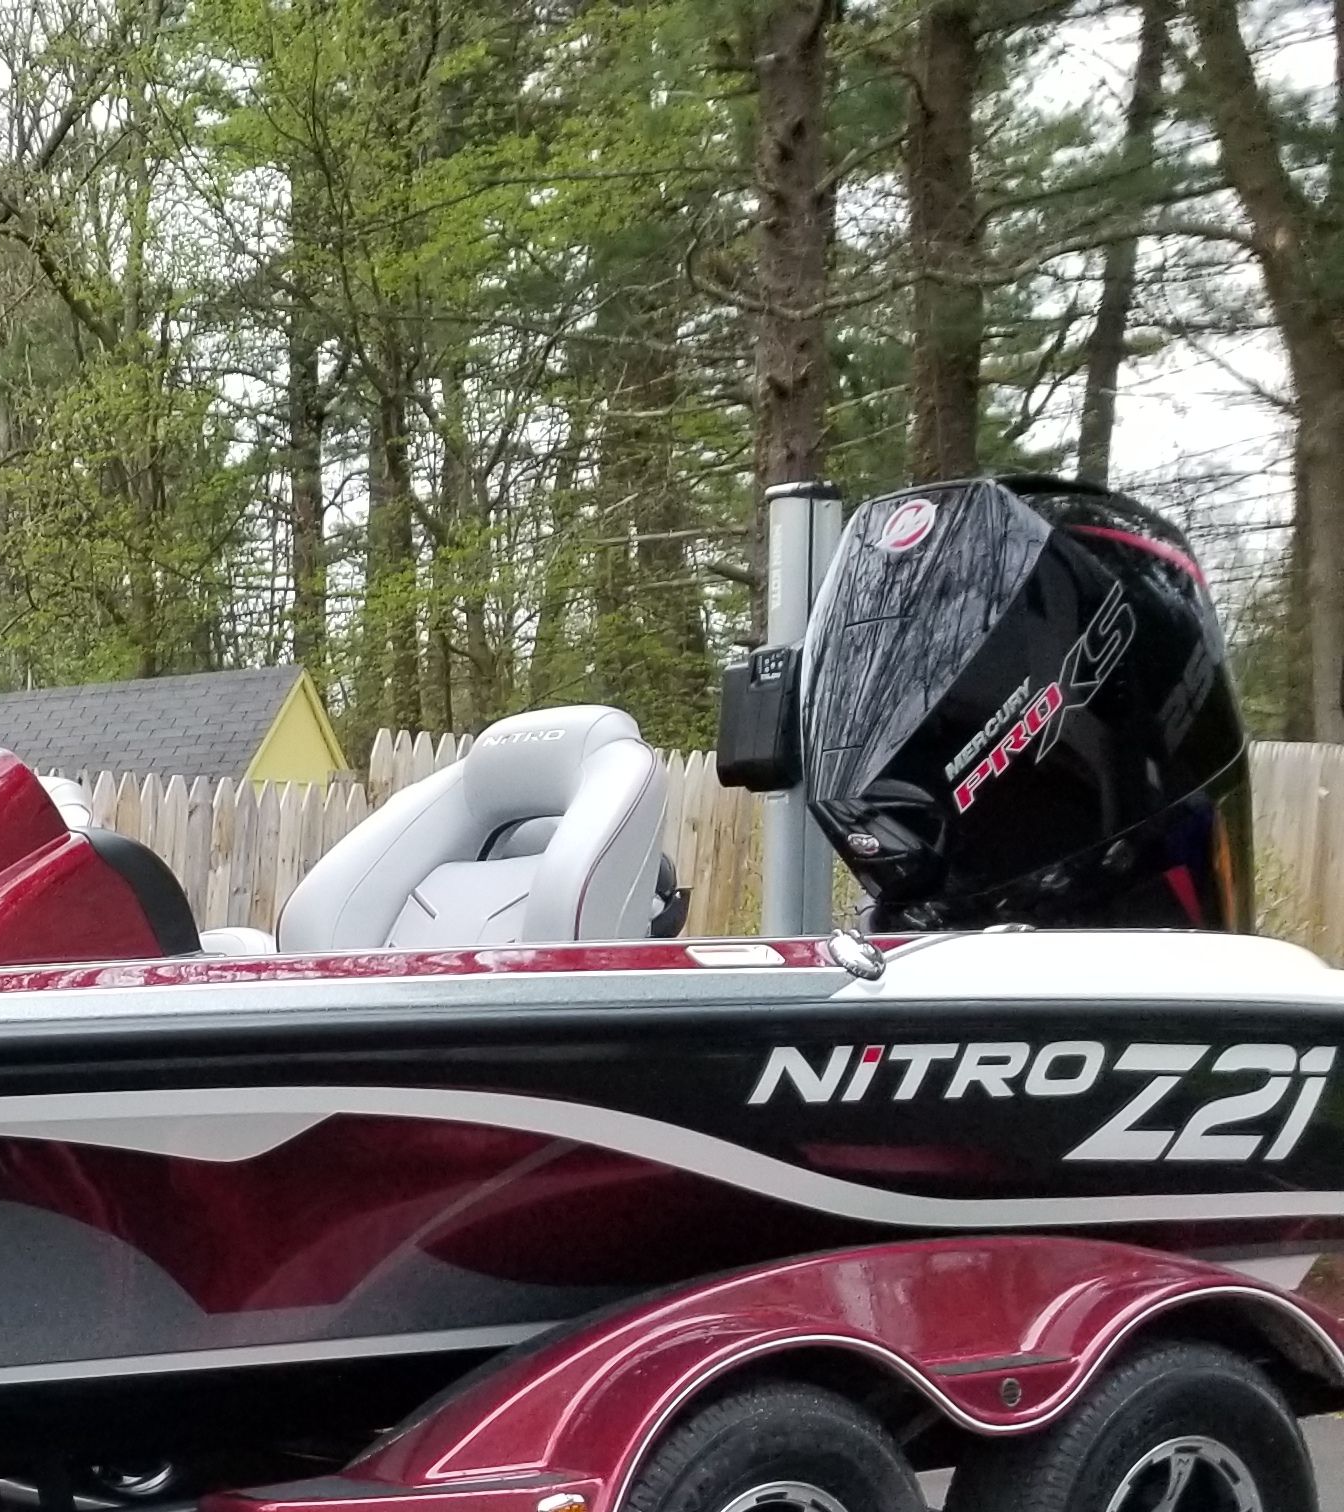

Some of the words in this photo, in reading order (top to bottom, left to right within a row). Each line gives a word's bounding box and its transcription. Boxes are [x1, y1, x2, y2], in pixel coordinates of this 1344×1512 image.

[944, 675, 1031, 782] MERCURY
[953, 681, 1063, 815] PRO
[1034, 579, 1137, 766] XS
[1062, 1043, 1337, 1161] Z21
